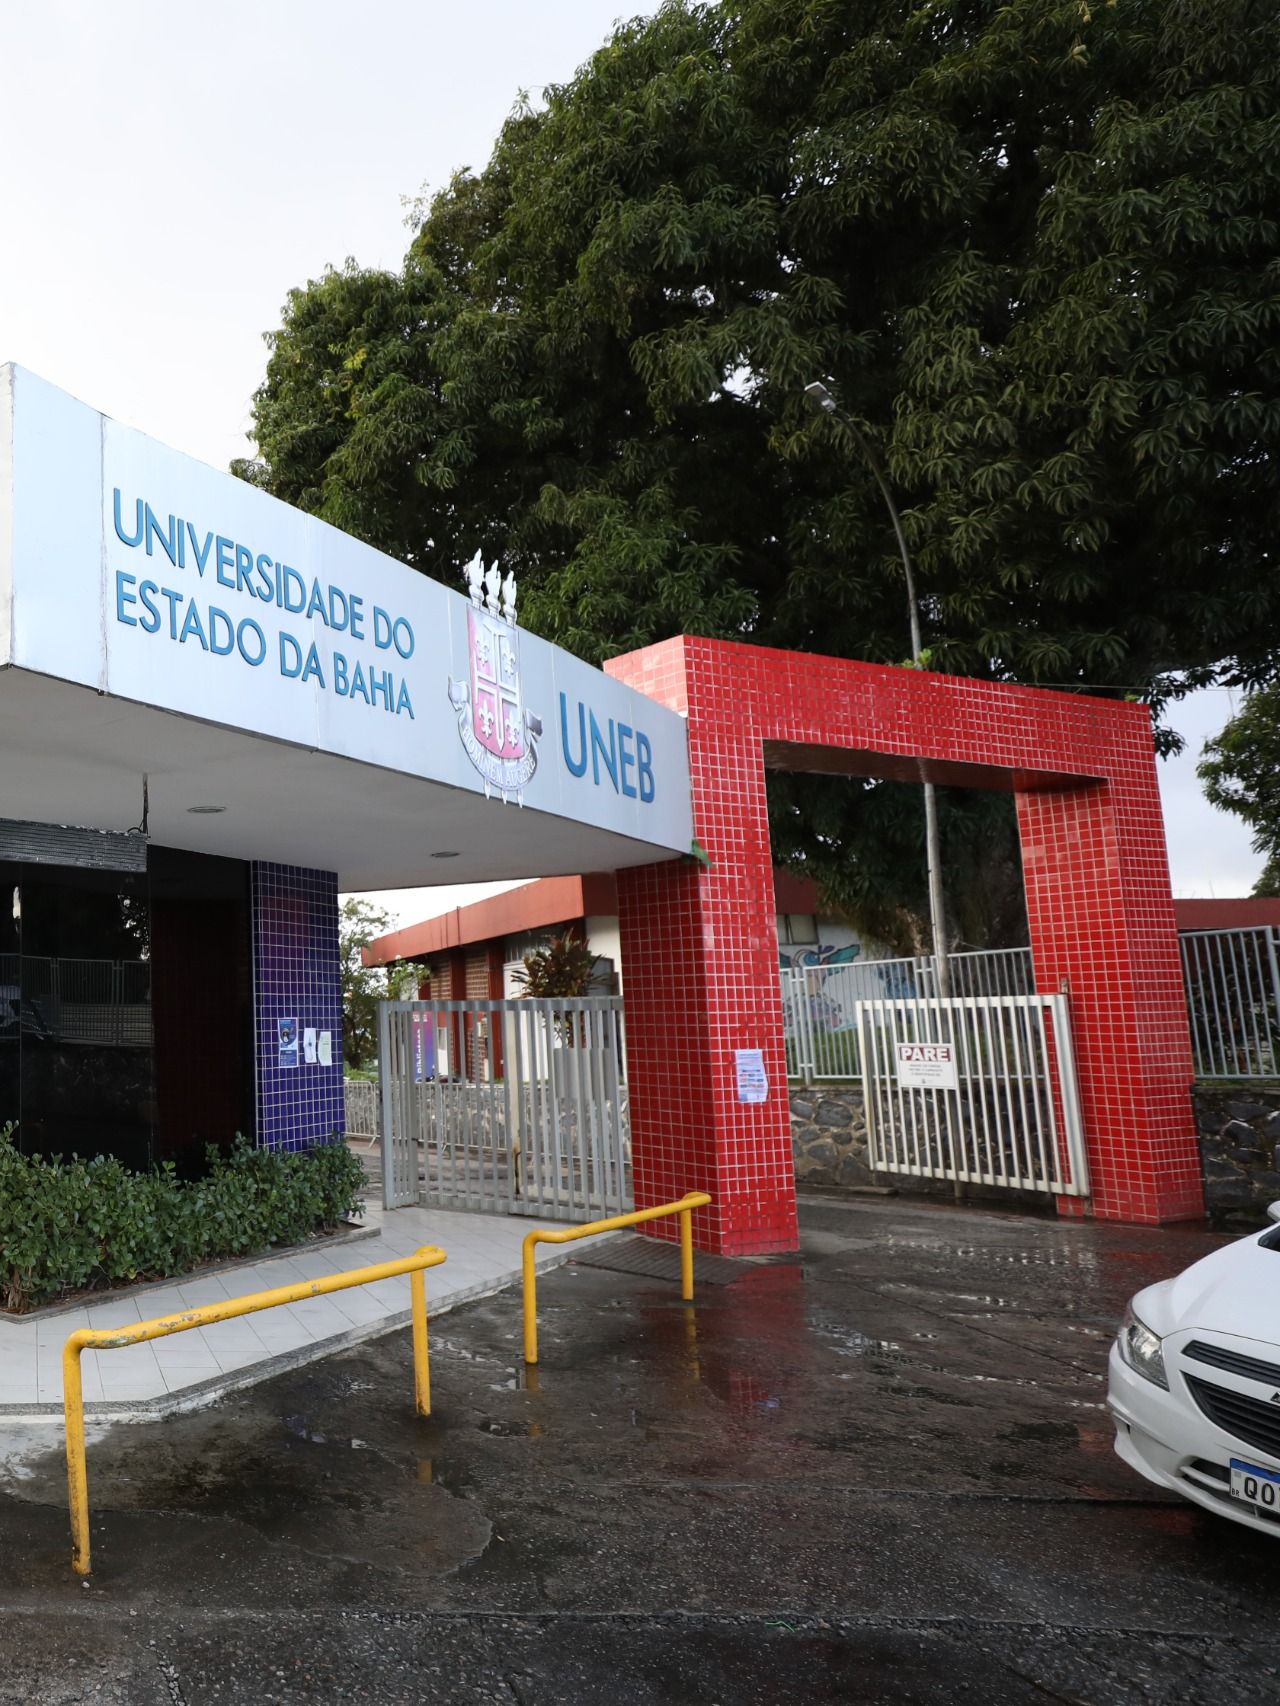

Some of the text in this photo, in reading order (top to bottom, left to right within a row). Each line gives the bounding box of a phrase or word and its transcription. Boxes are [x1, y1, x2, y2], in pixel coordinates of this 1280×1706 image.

[113, 487, 415, 660] UNIVERSIDADE DO
[116, 570, 415, 720] ESTADO DA BAHIA
[559, 691, 656, 804] UNEB
[901, 1047, 949, 1061] PARE
[1231, 1487, 1240, 1497] BR
[1244, 1476, 1280, 1506] QO
